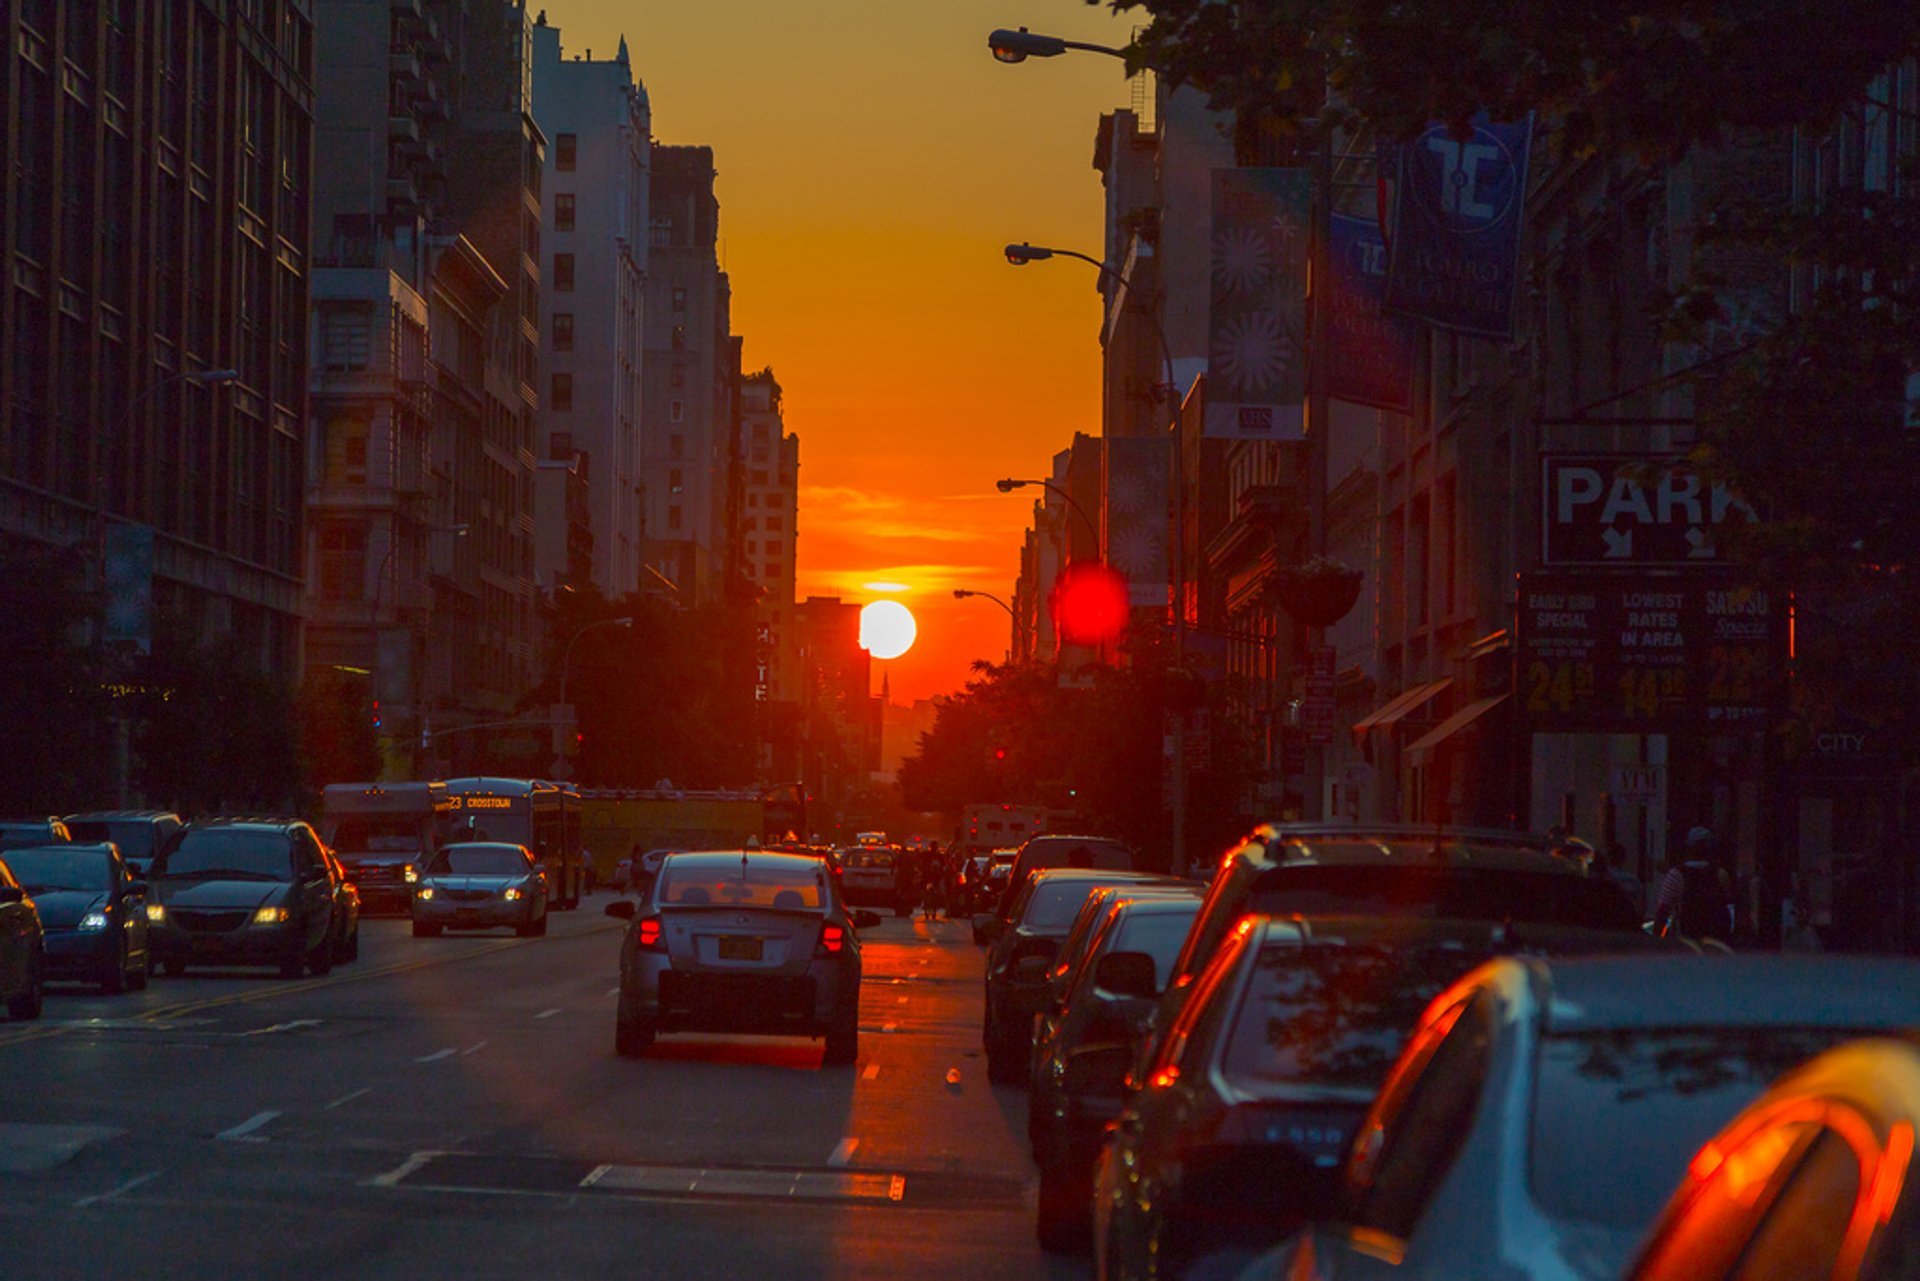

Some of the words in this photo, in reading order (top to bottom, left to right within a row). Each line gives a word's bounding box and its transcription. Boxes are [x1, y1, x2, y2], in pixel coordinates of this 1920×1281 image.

[1622, 593, 1684, 609] LOWEST
[1537, 612, 1588, 628] SPECIAL
[1629, 612, 1678, 628] RATES
[1621, 632, 1637, 646] IN
[1641, 632, 1684, 646] AREA
[755, 627, 769, 716] HOTE
[1817, 733, 1866, 751] CITY
[467, 797, 512, 809] CROSSTOWN
